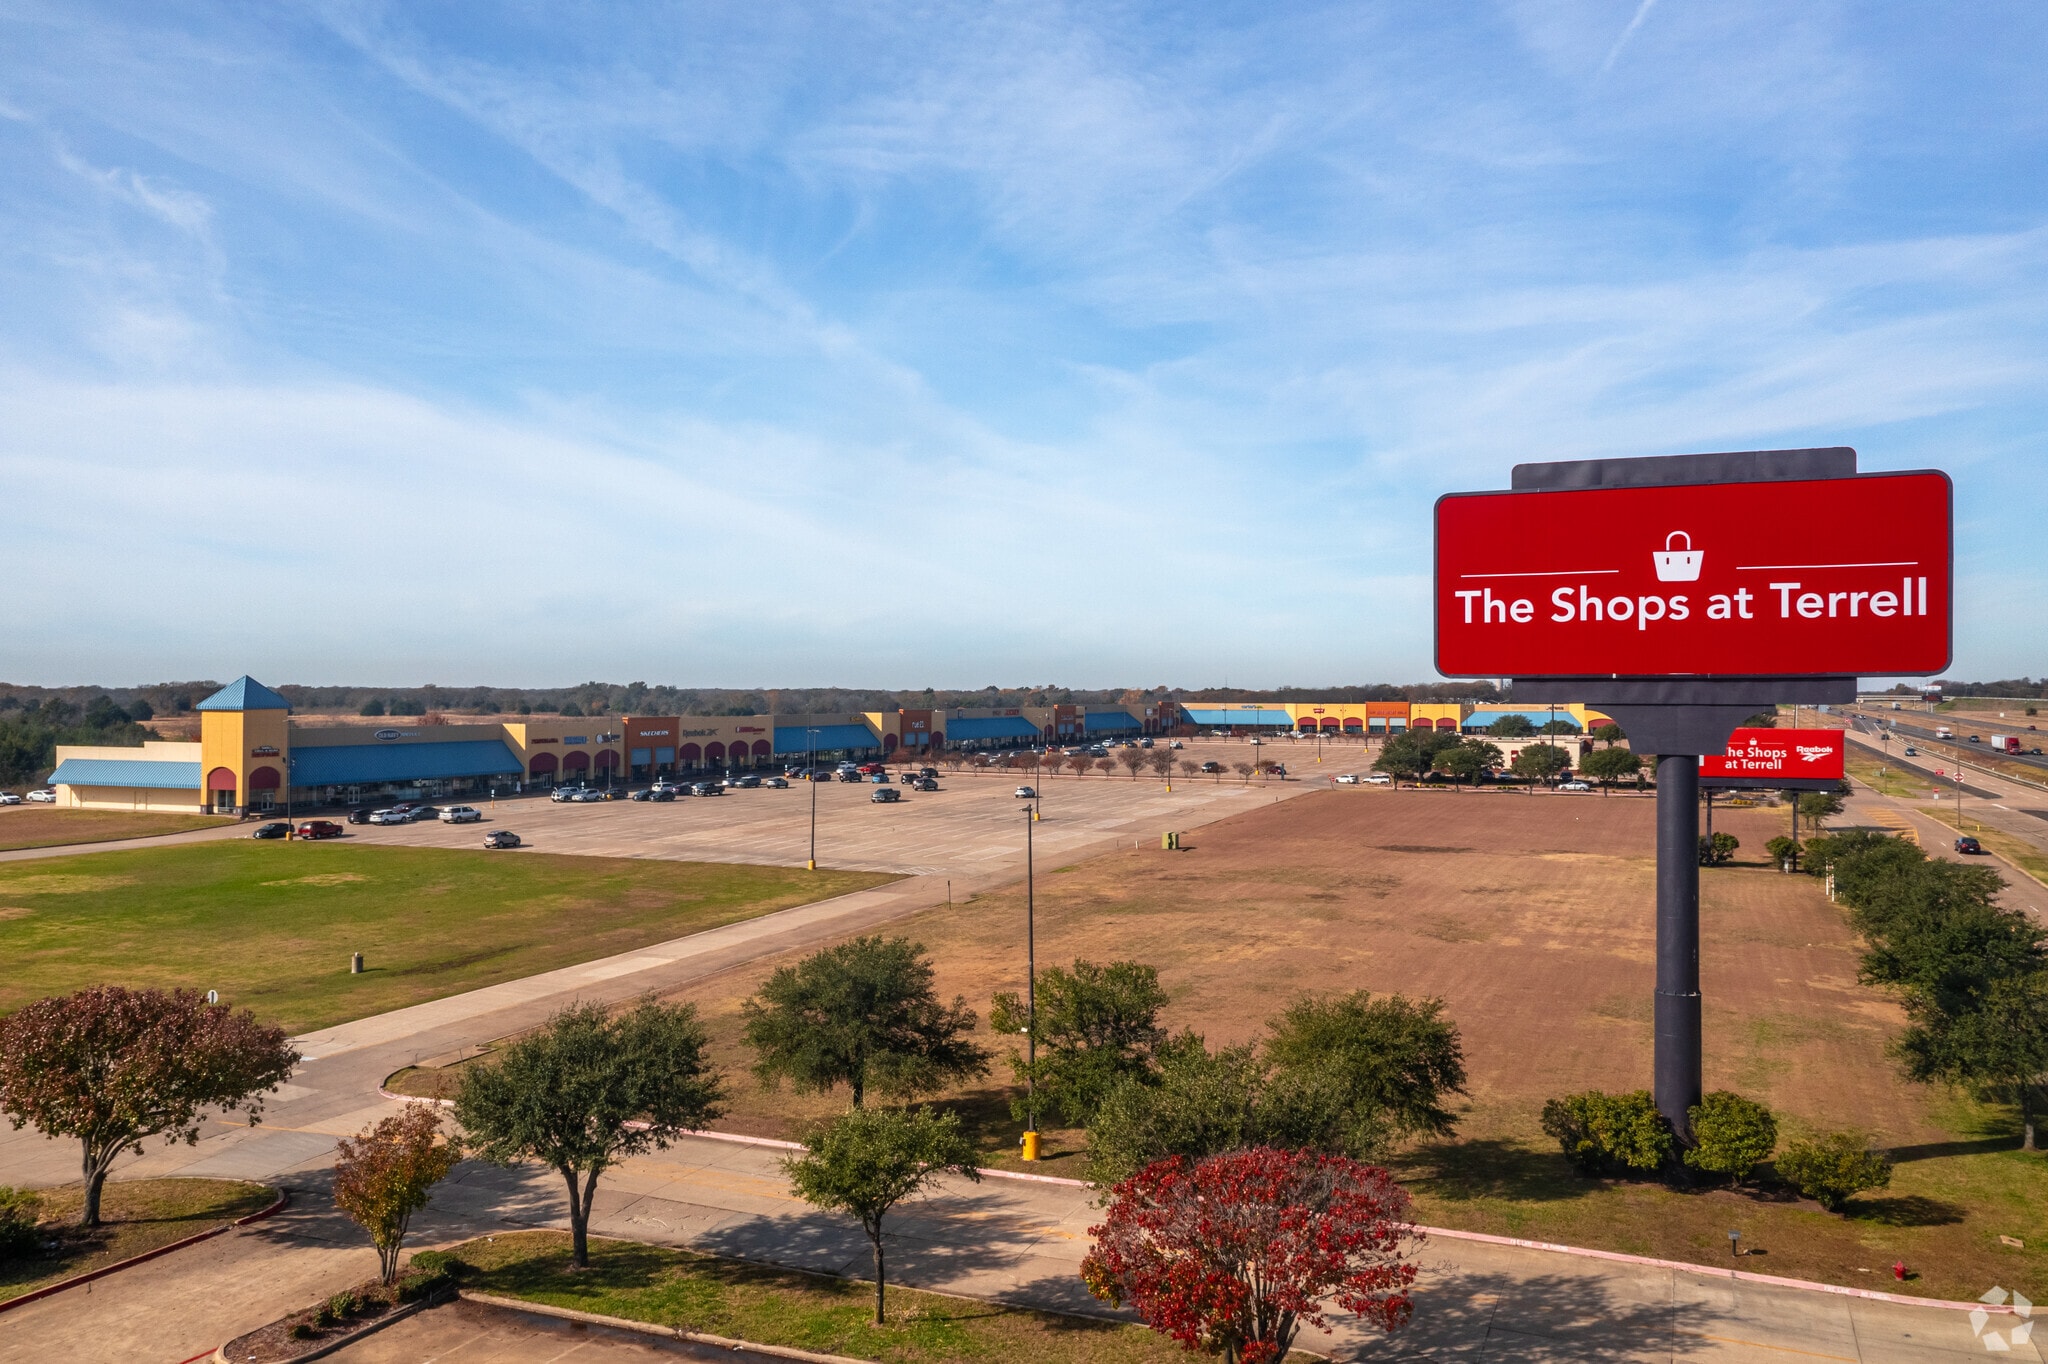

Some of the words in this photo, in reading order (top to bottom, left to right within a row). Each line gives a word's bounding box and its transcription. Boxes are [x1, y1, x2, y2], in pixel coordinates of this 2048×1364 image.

[1454, 587, 1535, 624] The
[1550, 584, 1691, 631] Shops
[1706, 587, 1754, 620] at
[1769, 576, 1928, 618] Terrell
[1726, 746, 1744, 757] he
[1747, 746, 1787, 760] Shops
[1796, 745, 1833, 753] Reebok
[1725, 760, 1738, 769] at
[1740, 759, 1782, 769] Terrell
